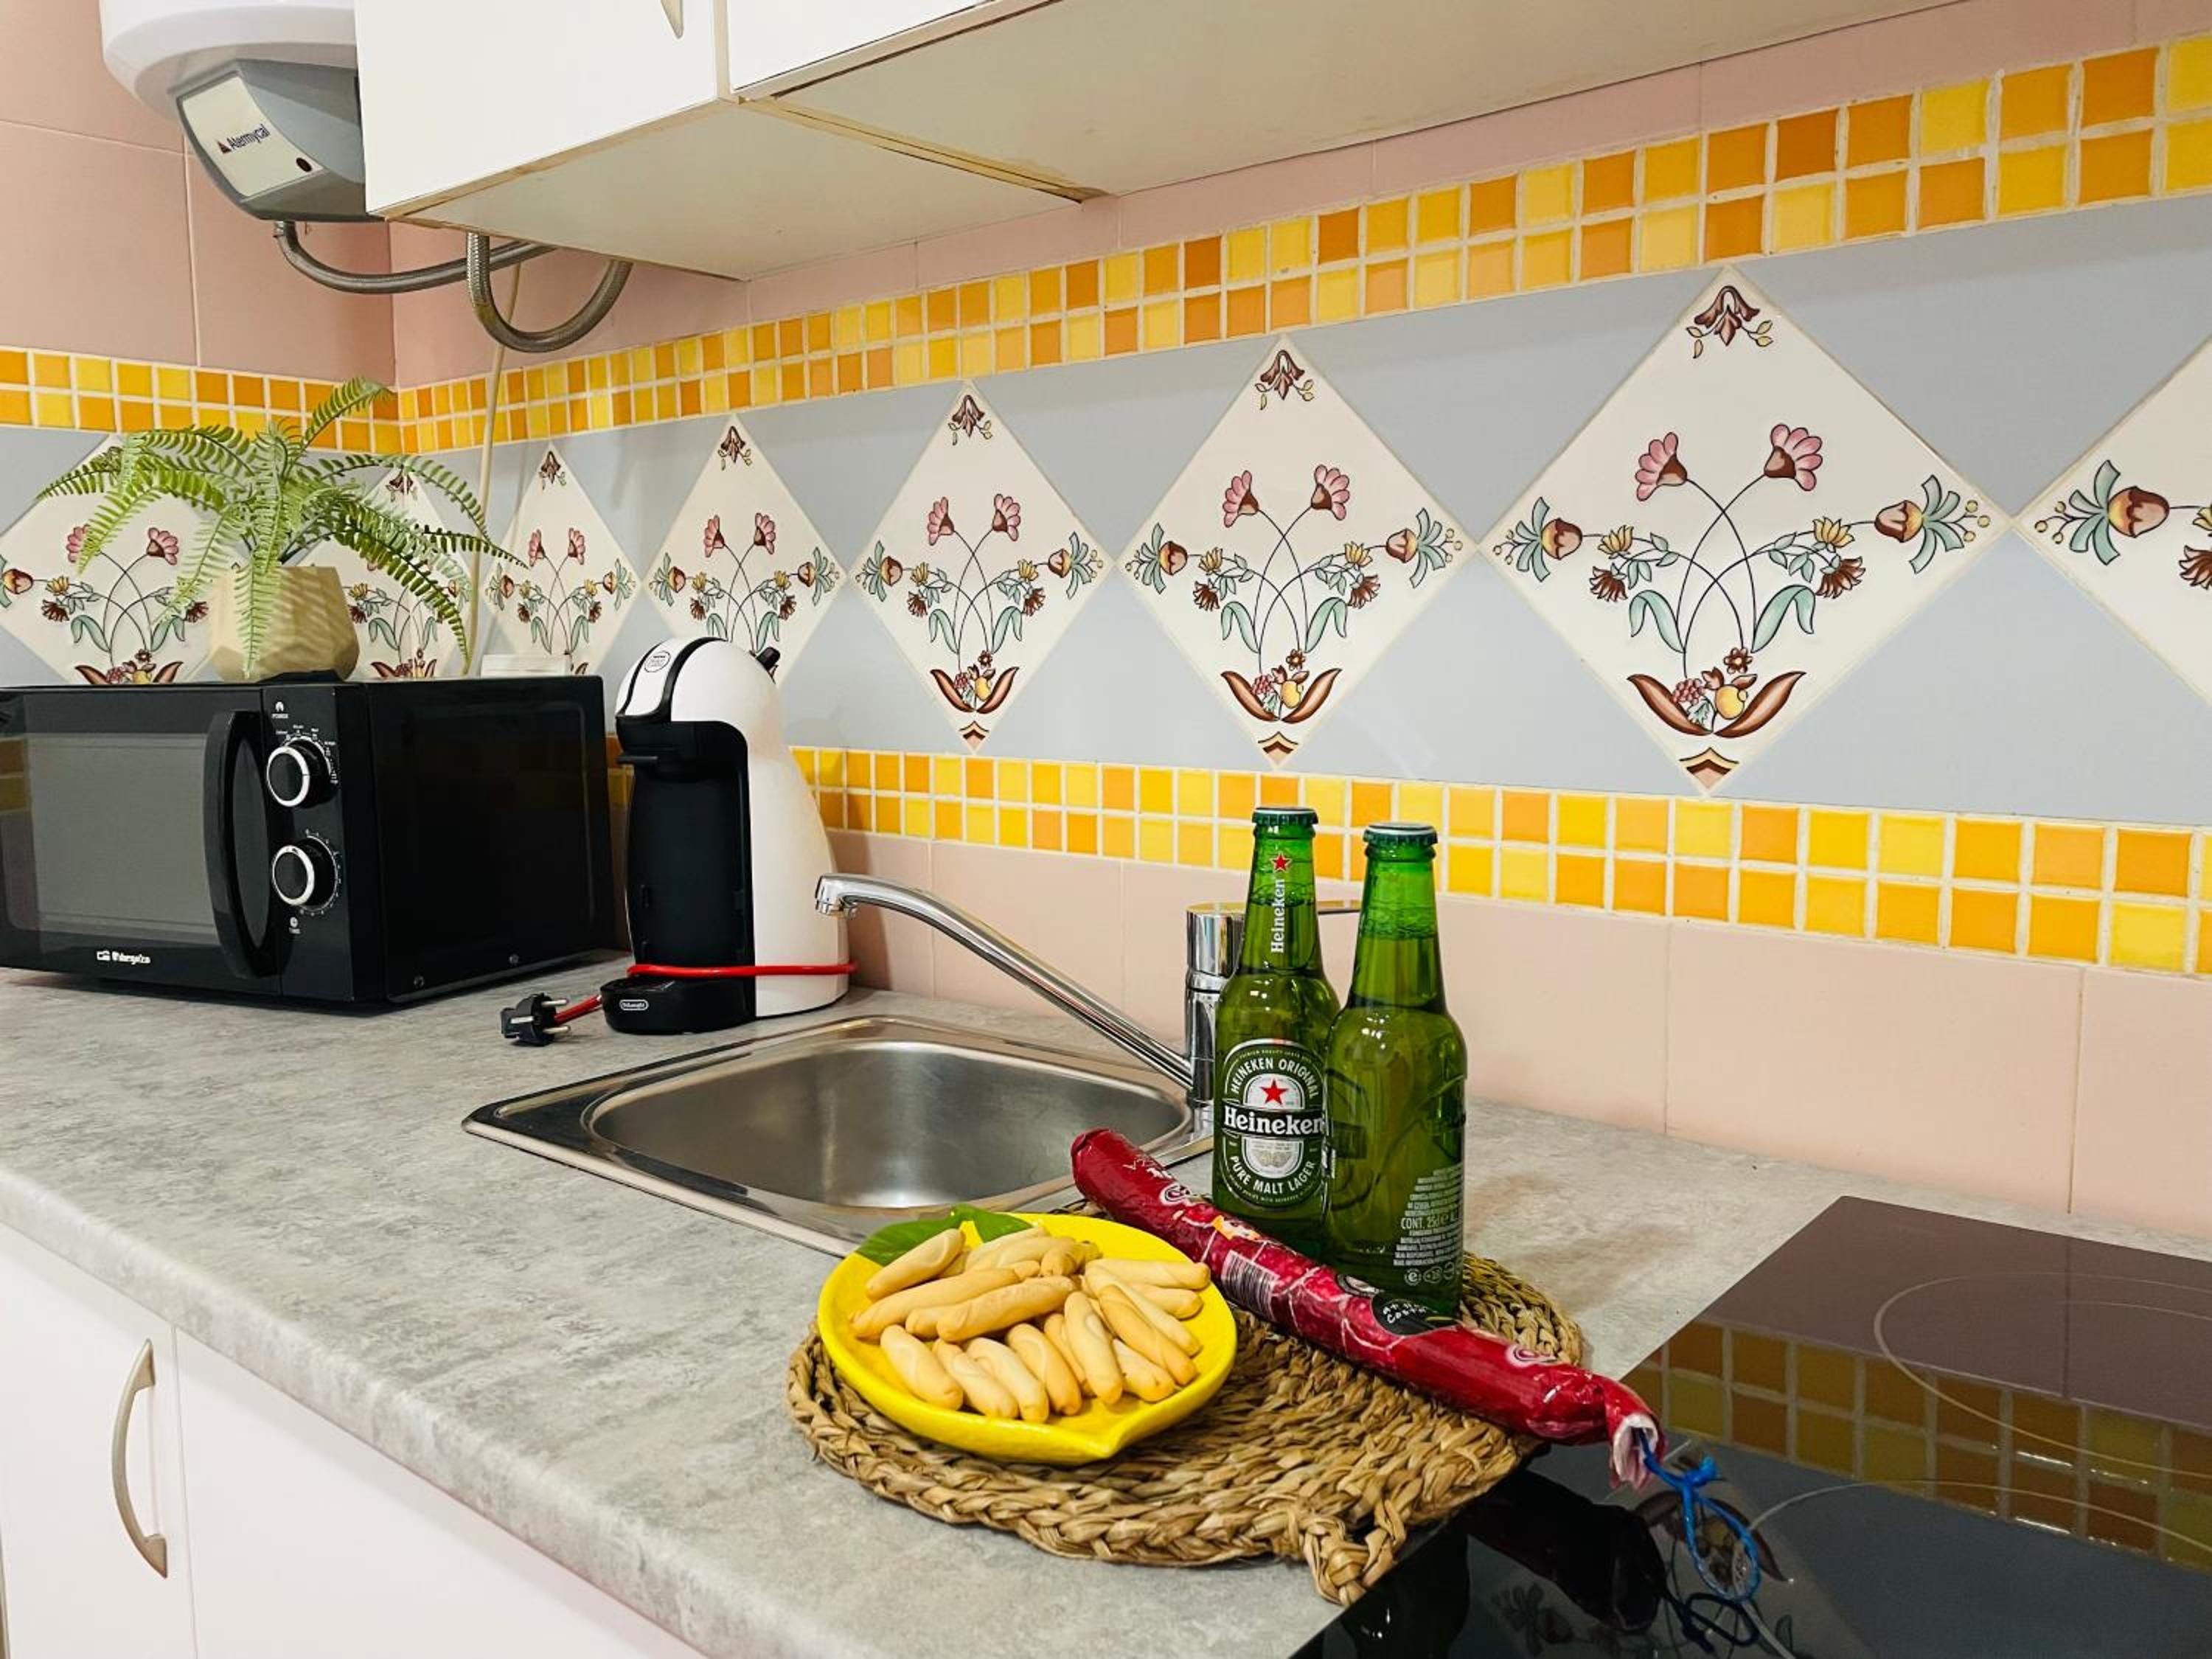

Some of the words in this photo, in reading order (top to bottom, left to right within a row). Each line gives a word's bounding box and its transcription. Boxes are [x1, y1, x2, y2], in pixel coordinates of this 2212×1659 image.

[1270, 878, 1285, 953] Heineken
[1231, 1057, 1274, 1094] HEINEKEN
[1278, 1057, 1320, 1099] ORIGINAL
[1224, 1105, 1326, 1135] Heineken
[1230, 1155, 1251, 1186] PURE
[1253, 1179, 1284, 1195] MALT
[1289, 1161, 1316, 1192] LAGER
